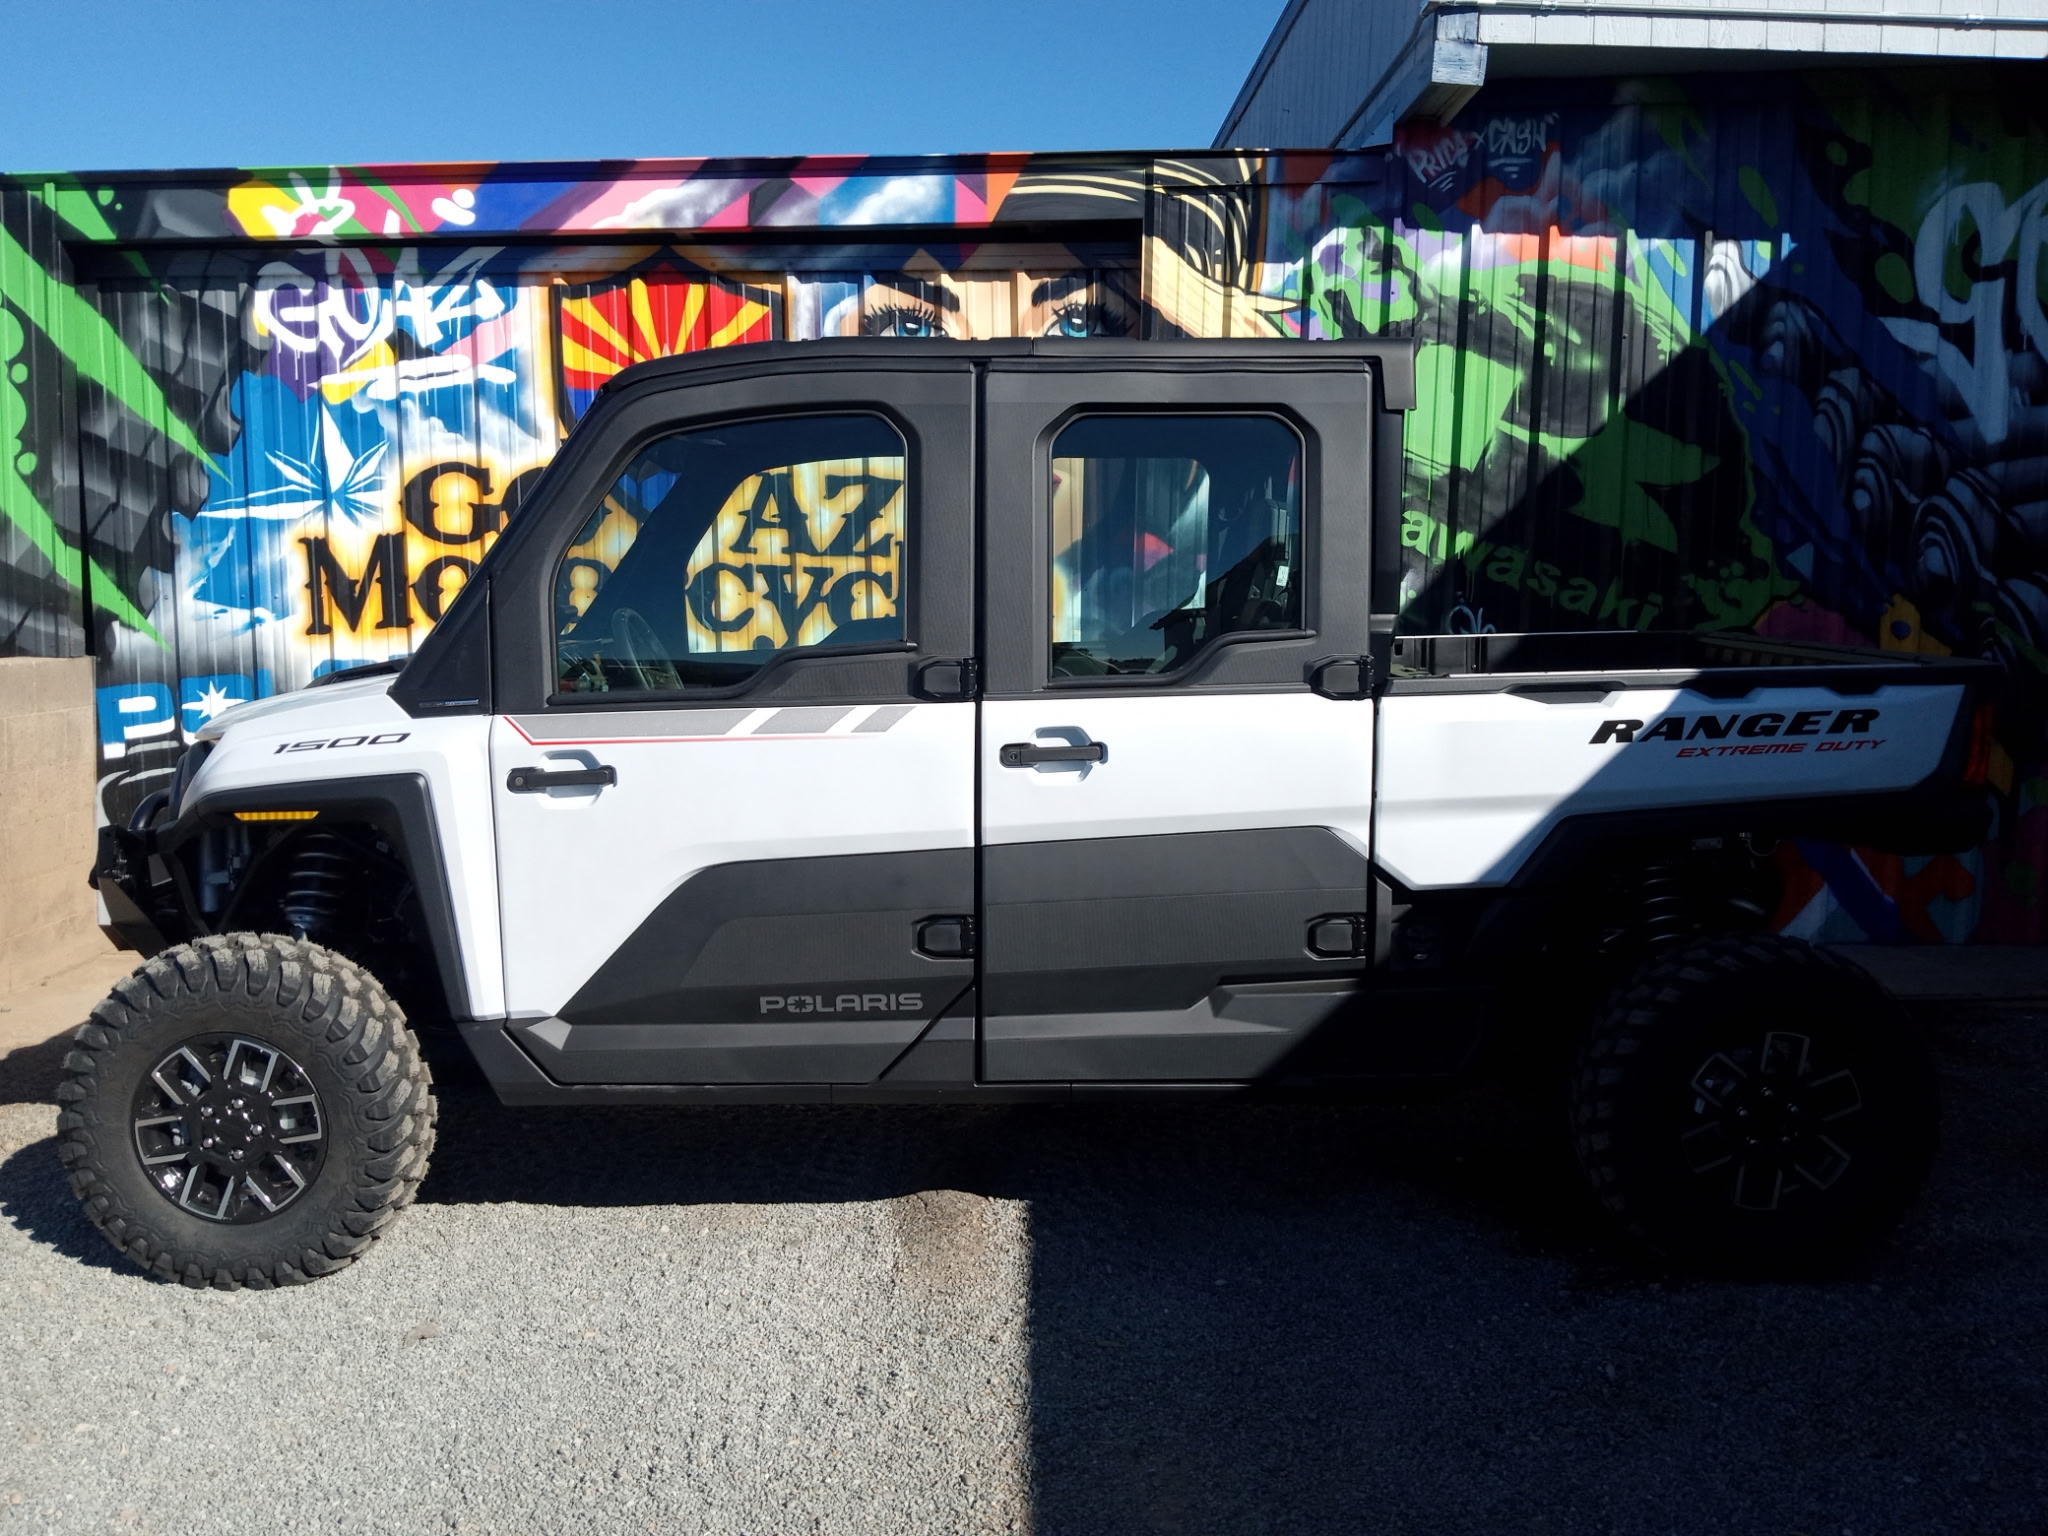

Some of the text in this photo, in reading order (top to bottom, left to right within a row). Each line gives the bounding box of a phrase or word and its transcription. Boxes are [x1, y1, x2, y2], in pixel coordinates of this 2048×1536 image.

[1400, 509, 1664, 631] awasaki
[1588, 708, 1880, 744] RANGER
[273, 732, 411, 755] 1500
[1675, 739, 1887, 758] EXTREME DUTY
[759, 992, 924, 1014] POLARIS
